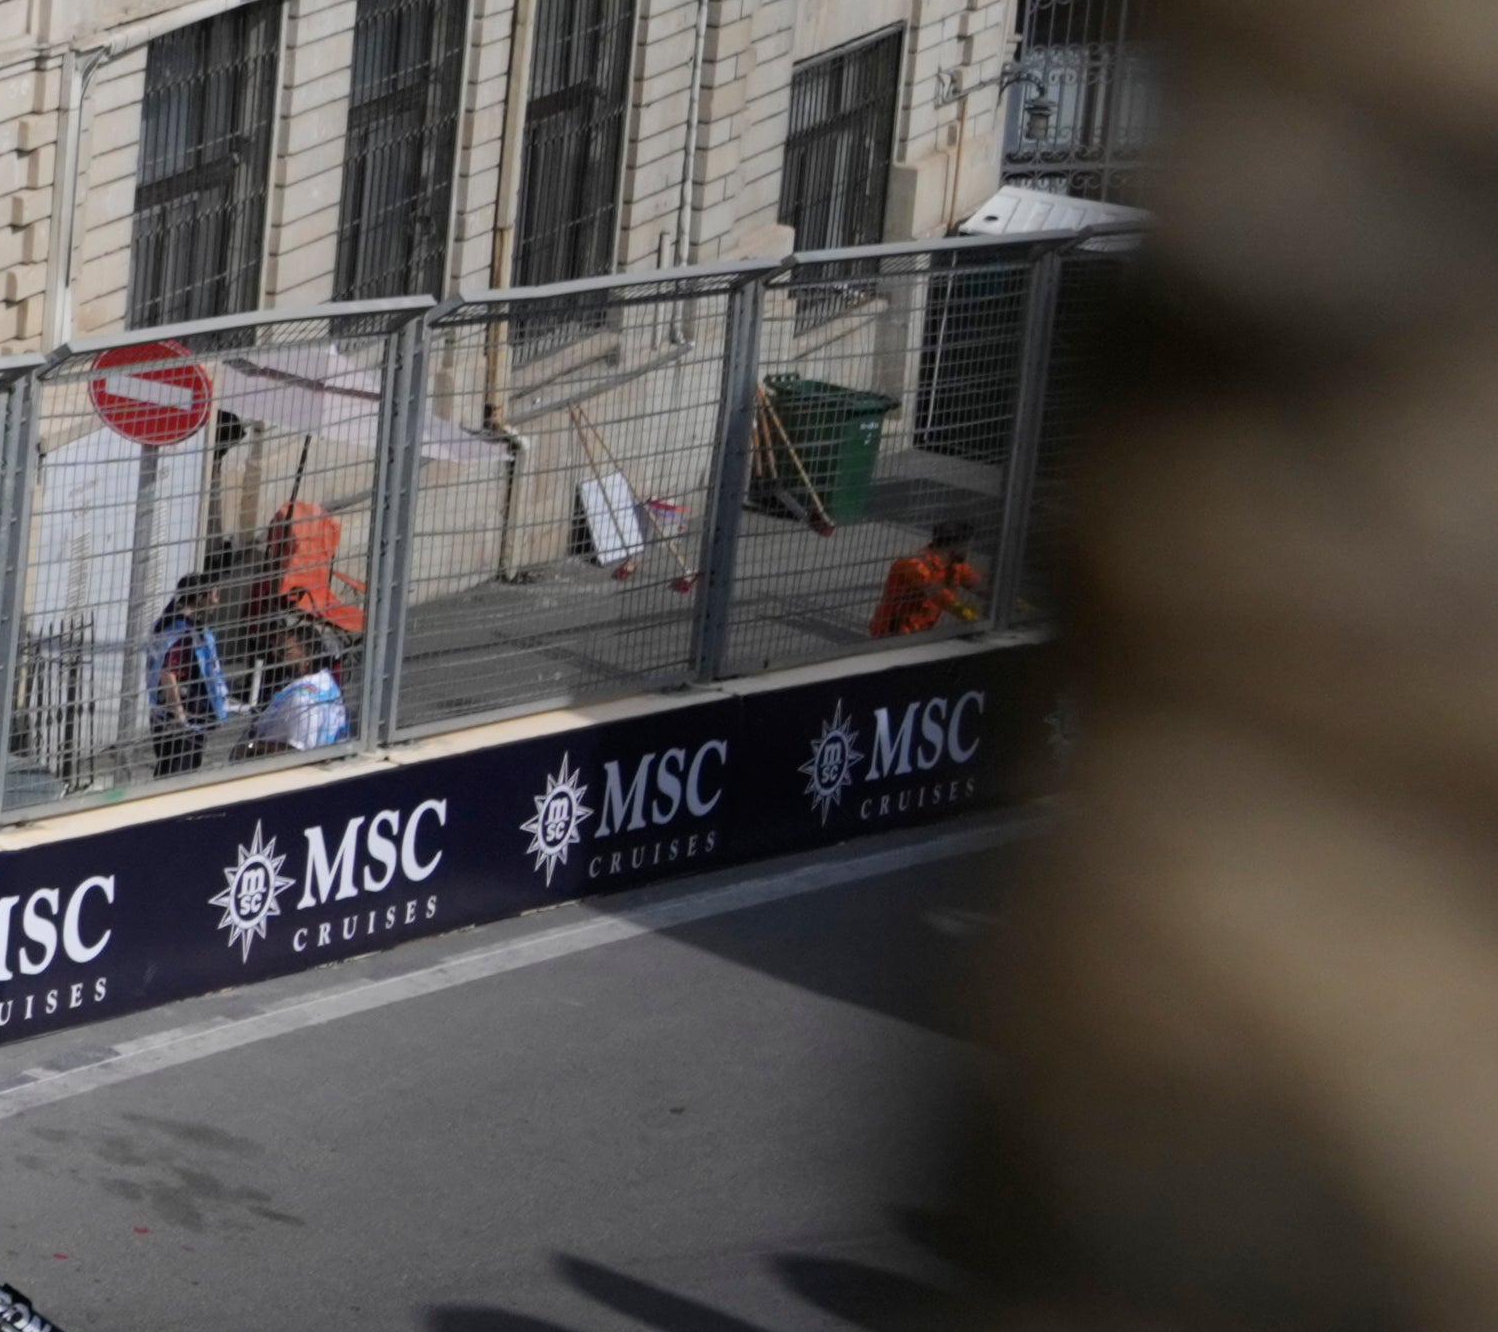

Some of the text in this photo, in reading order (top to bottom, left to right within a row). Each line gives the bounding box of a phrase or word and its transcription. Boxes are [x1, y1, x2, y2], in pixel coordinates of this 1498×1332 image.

[864, 690, 985, 782] MSC
[594, 739, 728, 839] MSC
[861, 777, 976, 820] CRUISES
[296, 798, 448, 910] MSC
[588, 830, 717, 878] CRUISES
[292, 895, 438, 952] CRUISES
